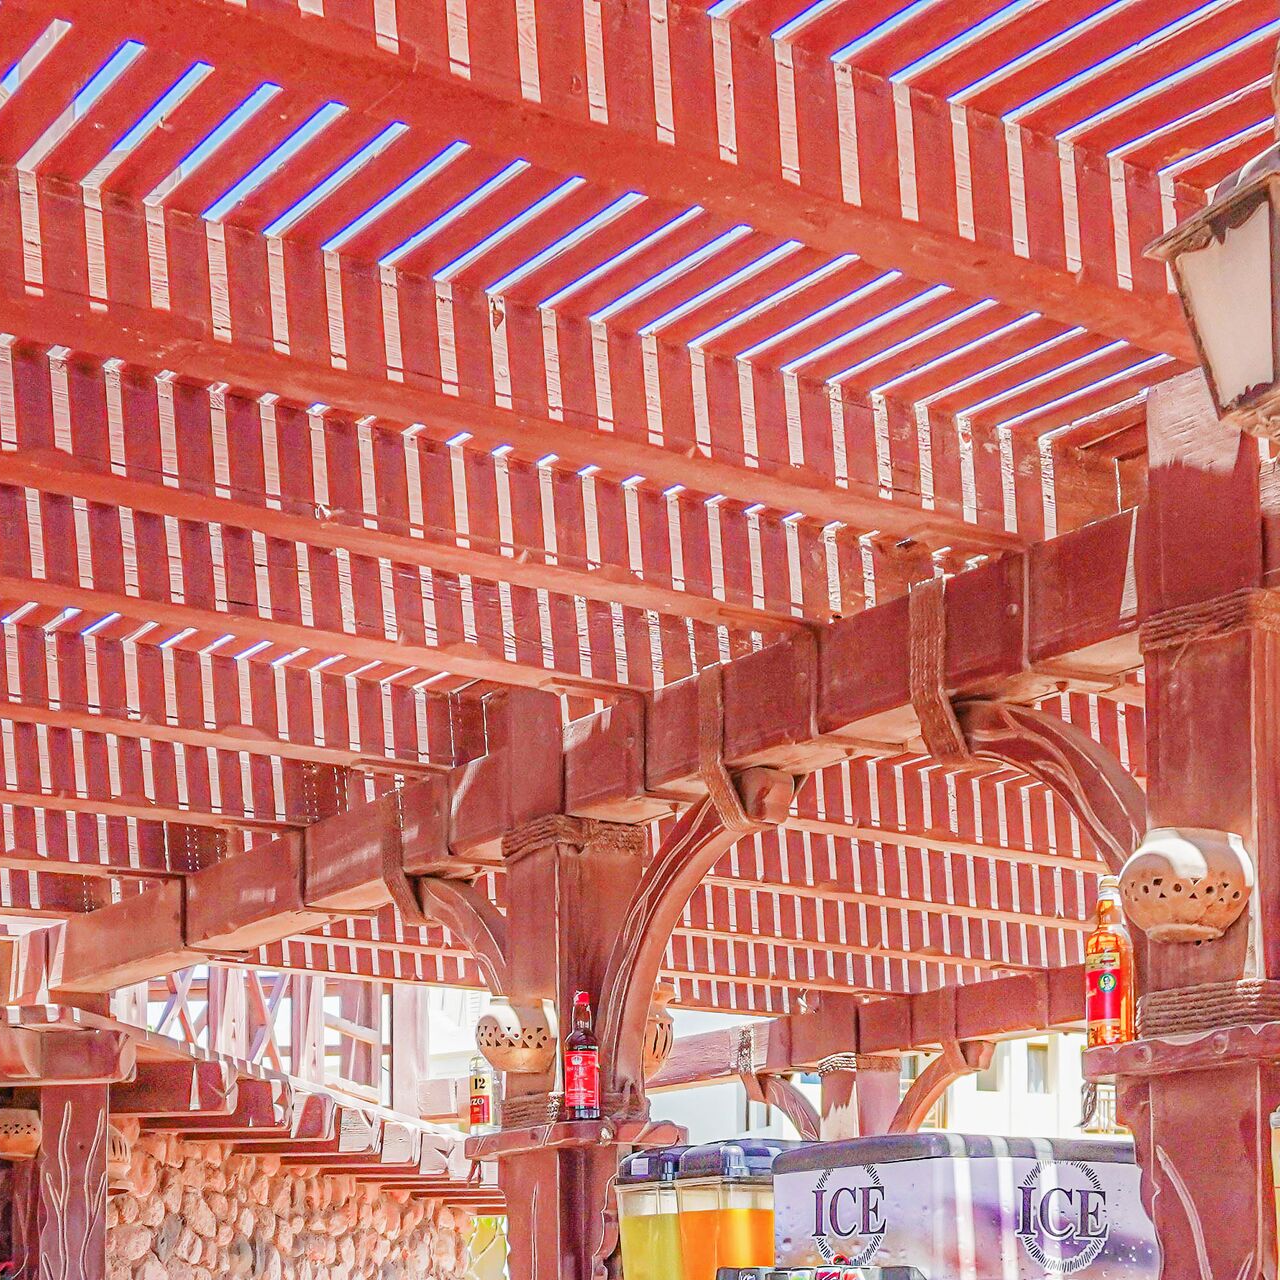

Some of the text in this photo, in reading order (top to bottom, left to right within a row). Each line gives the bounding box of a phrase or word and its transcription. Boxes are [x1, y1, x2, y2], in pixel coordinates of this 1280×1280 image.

[474, 1077, 486, 1089] 12
[811, 1184, 887, 1238] ICE
[1018, 1185, 1108, 1240] ICE
